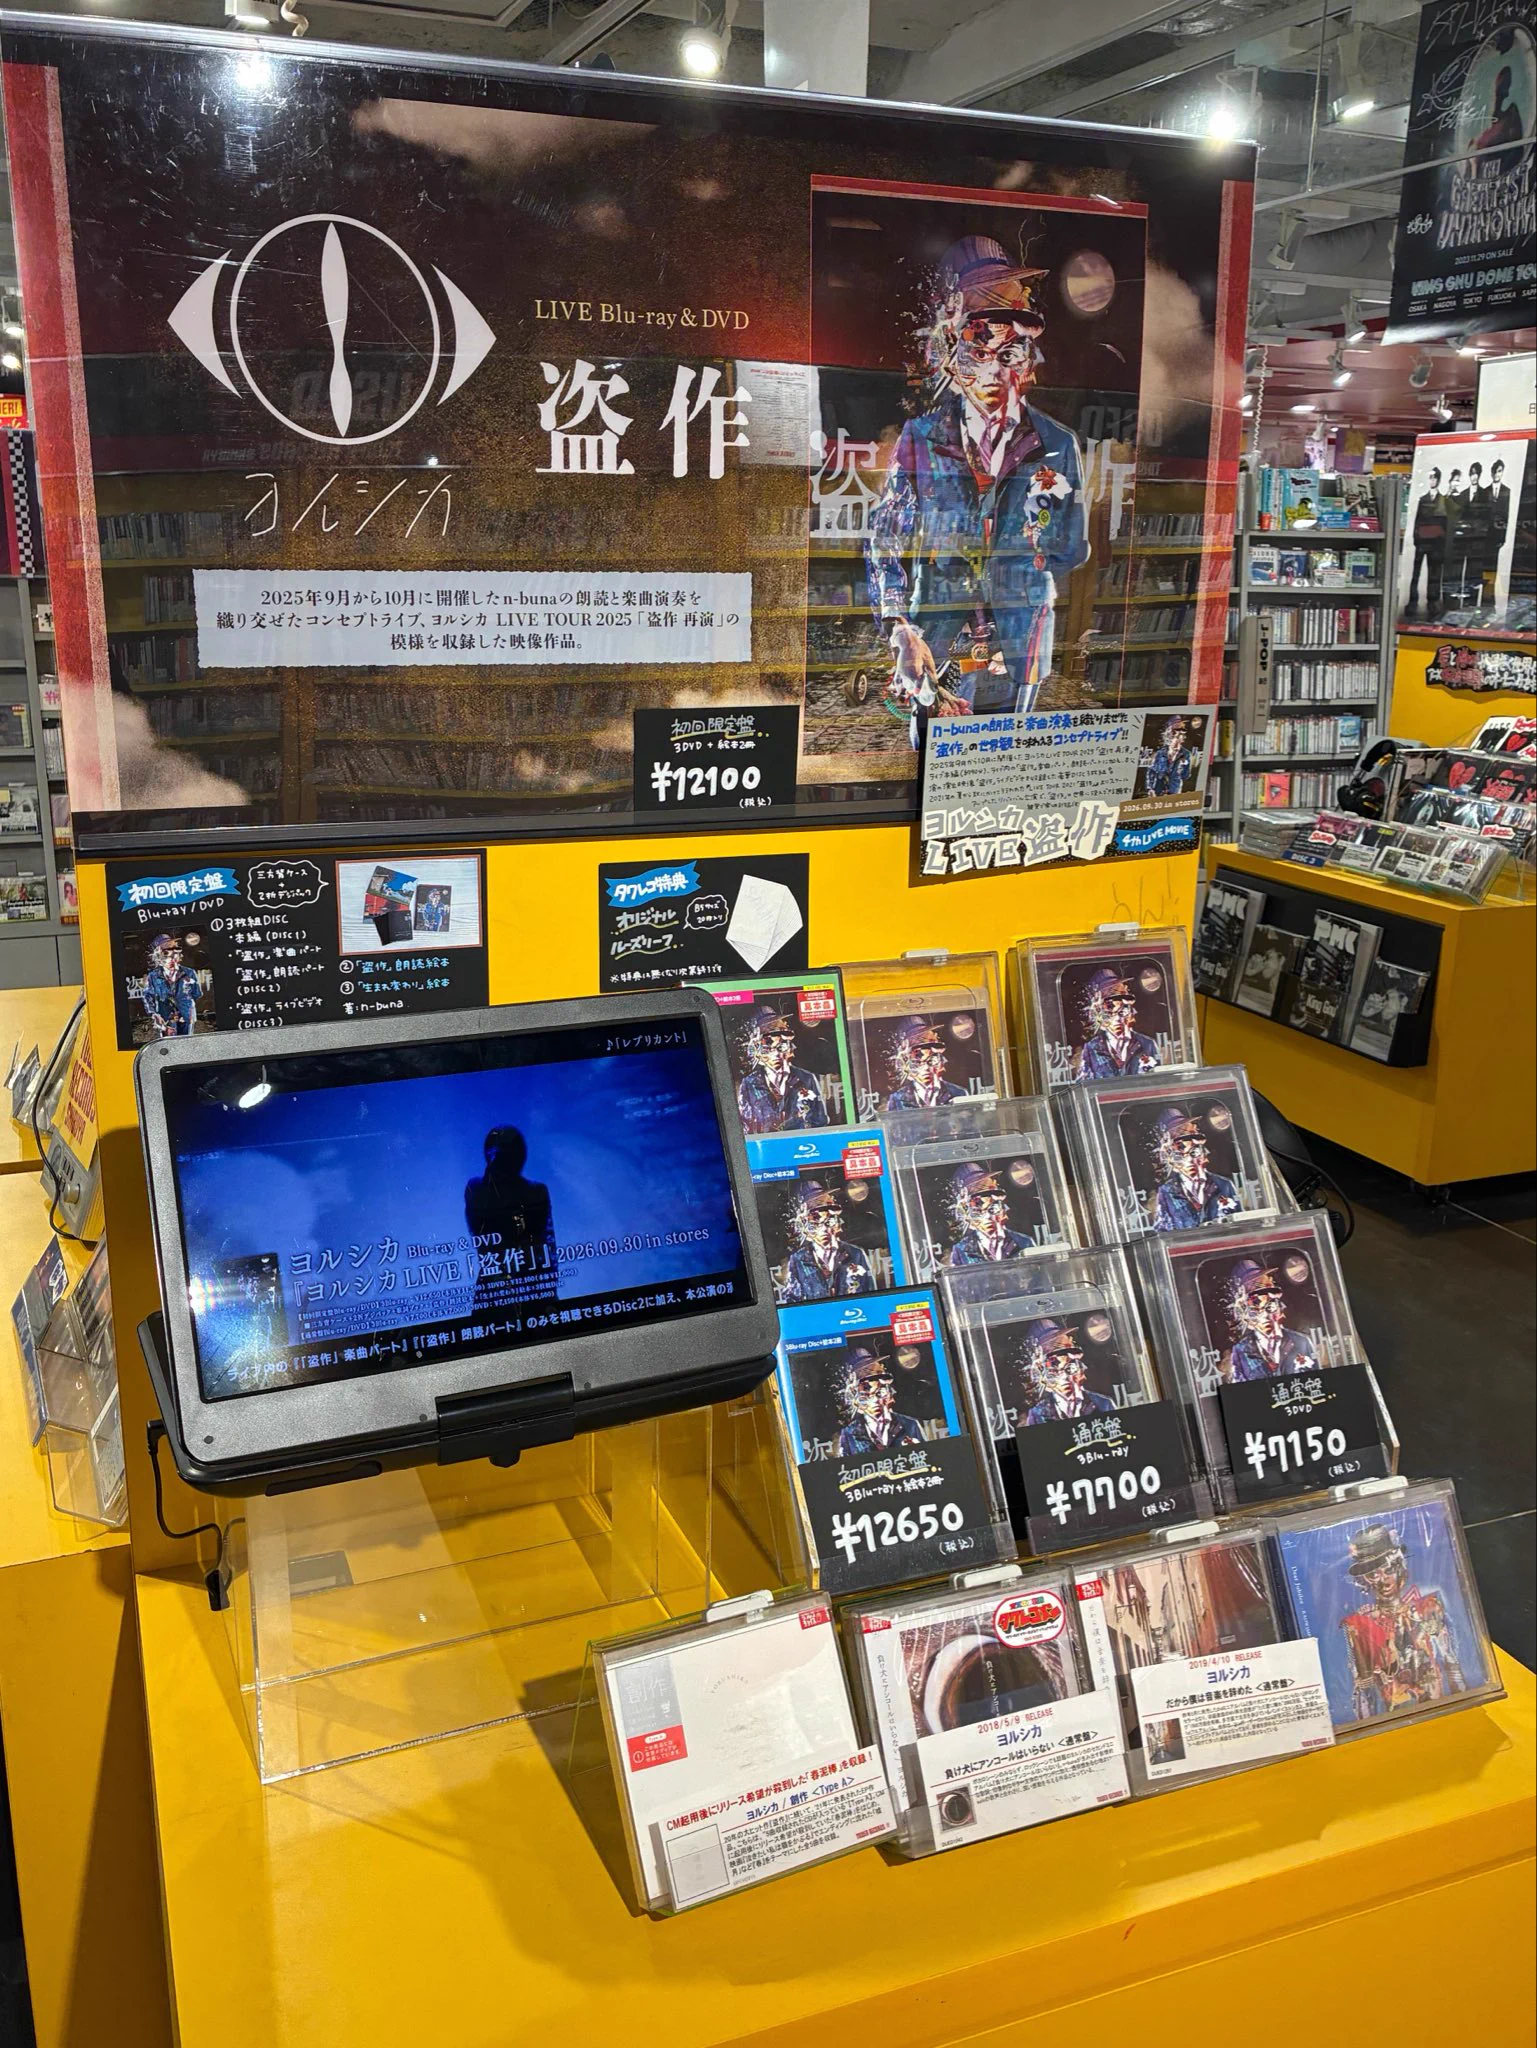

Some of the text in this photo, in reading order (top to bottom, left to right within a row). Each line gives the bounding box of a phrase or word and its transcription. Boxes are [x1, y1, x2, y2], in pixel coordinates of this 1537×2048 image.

[1486, 251, 1497, 260] ON
[1497, 248, 1514, 259] SALE
[1445, 275, 1474, 291] GNU
[1477, 266, 1513, 286] DOME
[535, 299, 749, 330] LIVE Blu-ray & DVD
[1408, 304, 1427, 313] OSAKA
[1433, 300, 1457, 309] NAGOYA
[1463, 296, 1482, 305] TOKYO
[1487, 291, 1516, 301] FUKUOKA
[535, 359, 752, 479] 盗作
[261, 589, 701, 607] 2025年9月から10月に開催したn-bunaの朗読と楽曲演奏を
[217, 611, 487, 629] 織り交ぜたコンセプトライブ、ヨルシカ
[497, 613, 538, 627] LIVE
[544, 613, 592, 627] TOUR
[391, 633, 584, 650] 模様を収録した映像作品。
[674, 741, 702, 753] 3DVD
[651, 761, 761, 802] ¥12100
[1122, 834, 1141, 848] 4th
[927, 839, 1019, 872] LIVE
[128, 872, 227, 904] 初回限定盤
[614, 871, 688, 902] タワレコ特典
[138, 906, 187, 923] Blu-ray
[199, 898, 224, 911] DVD
[616, 907, 677, 928] オリジナル
[610, 934, 674, 956] ルーズリーフ
[291, 1232, 502, 1276] ヨルシカ Blu-ray & DVD
[556, 1235, 642, 1264] 2026.09.30
[645, 1233, 662, 1249] in
[665, 1227, 710, 1246] stores
[1272, 1378, 1325, 1403] 通常盤
[1285, 1405, 1312, 1416] 3DVD
[1072, 1416, 1127, 1445] 通常盤
[1245, 1426, 1346, 1479] ¥7150
[1047, 1466, 1161, 1525] ¥7700
[832, 1503, 964, 1564] ¥12650
[1189, 1651, 1262, 1670] 2019/4/10 RELEASE
[1207, 1665, 1250, 1684] ヨルシカ
[977, 1708, 1054, 1735] 2018/5/9 RELEASE
[997, 1724, 1042, 1747] ヨルシカ
[945, 1743, 1055, 1780] 負け犬にアンコールはいらない
[746, 1802, 779, 1821] ヨルシカ
